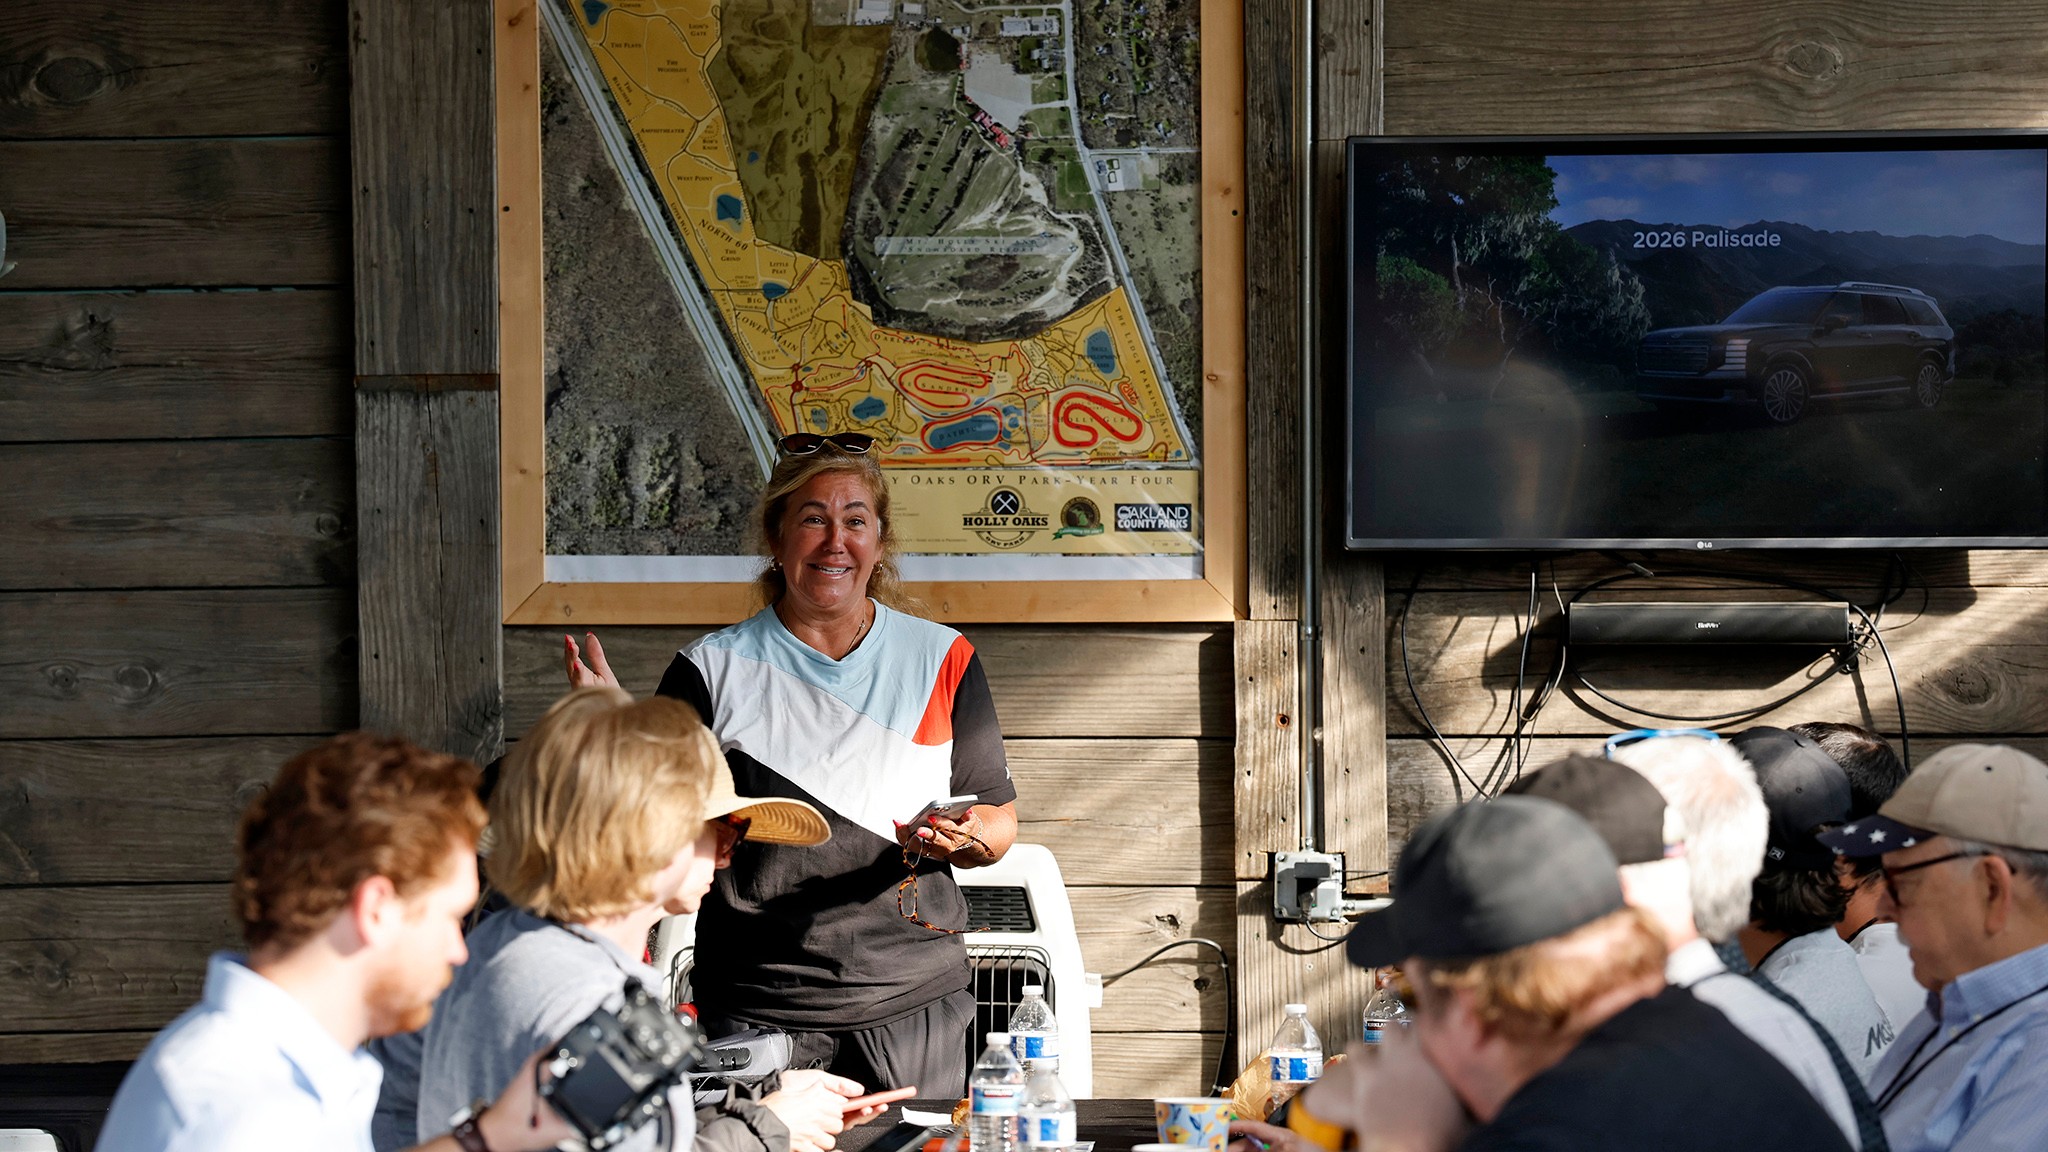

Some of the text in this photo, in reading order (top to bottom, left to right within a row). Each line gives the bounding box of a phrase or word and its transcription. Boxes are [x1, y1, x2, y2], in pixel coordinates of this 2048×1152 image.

[699, 219, 733, 243] NORTH
[735, 241, 749, 251] 60
[1633, 230, 1782, 248] 2026 Palisade
[735, 311, 768, 335] LOWER
[772, 331, 799, 352] MAIN
[1114, 306, 1126, 327] THE
[1139, 368, 1161, 413] PARKING
[910, 474, 955, 485] OAKS
[967, 475, 1005, 485] ORV
[1130, 474, 1174, 485] FOUR
[1116, 505, 1189, 520] OAKLAND
[963, 517, 1049, 526] HOLLY OAKS
[1117, 519, 1188, 529] COUNTY PARKS
[985, 536, 1025, 547] ORV PARK
